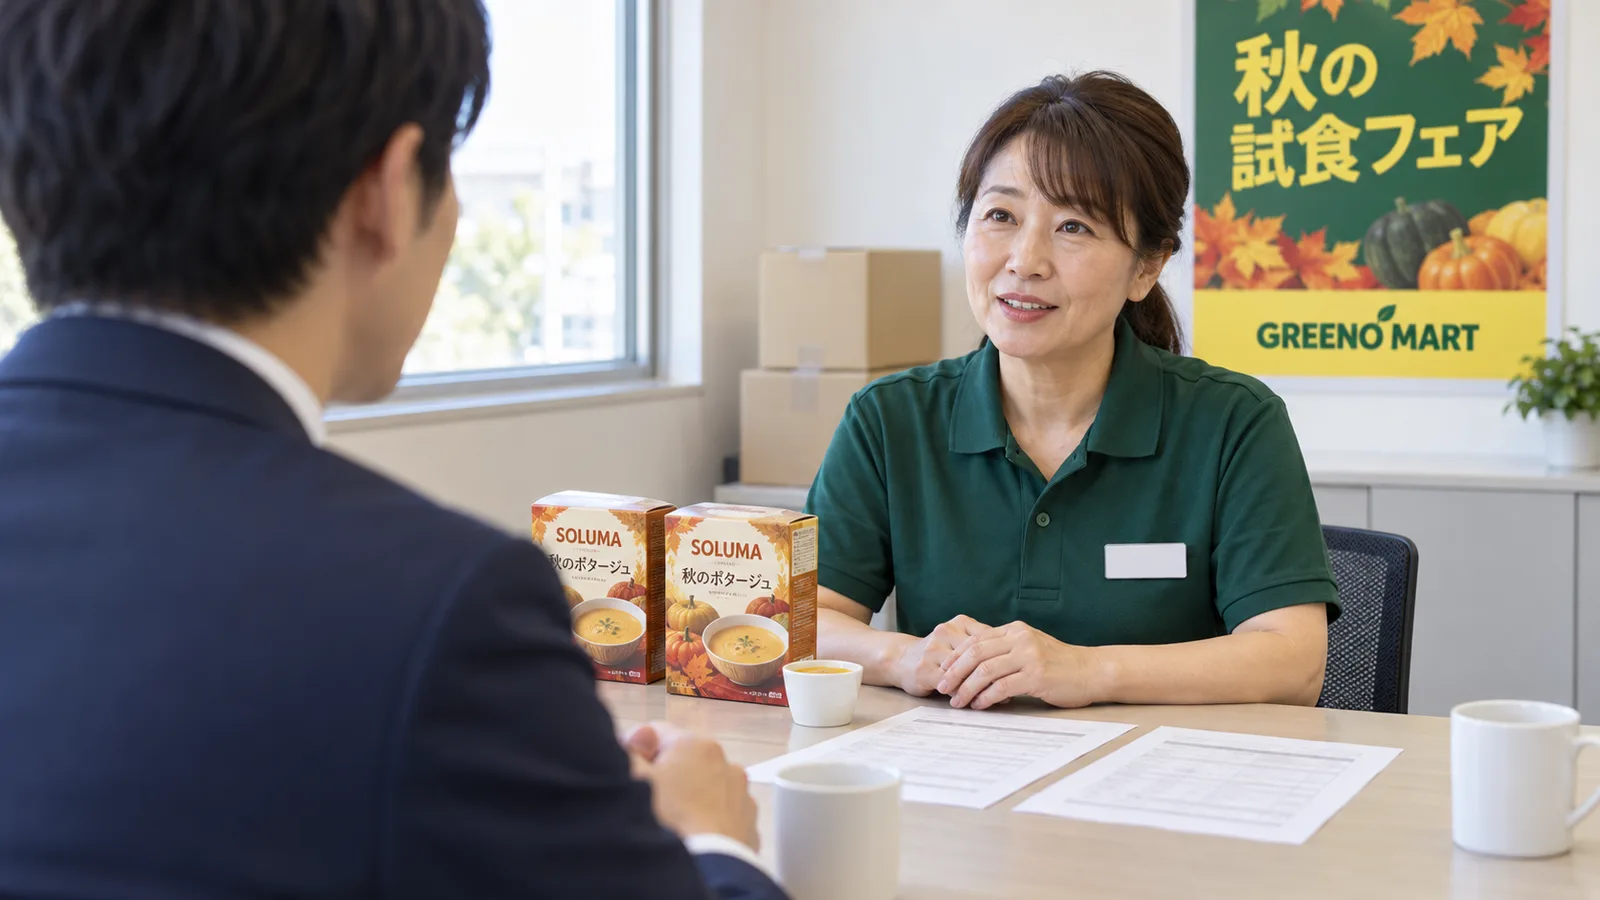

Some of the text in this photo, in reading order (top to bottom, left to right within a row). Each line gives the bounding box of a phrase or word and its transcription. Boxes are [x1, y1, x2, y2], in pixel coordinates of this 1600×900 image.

[1234, 29, 1378, 117] 秋の
[1230, 106, 1524, 191] 試食フェア
[1256, 322, 1480, 351] GREENO MART
[556, 527, 622, 547] SOLUMA
[691, 539, 762, 560] SOLUMA
[682, 567, 772, 590] 秋のポタージュ
